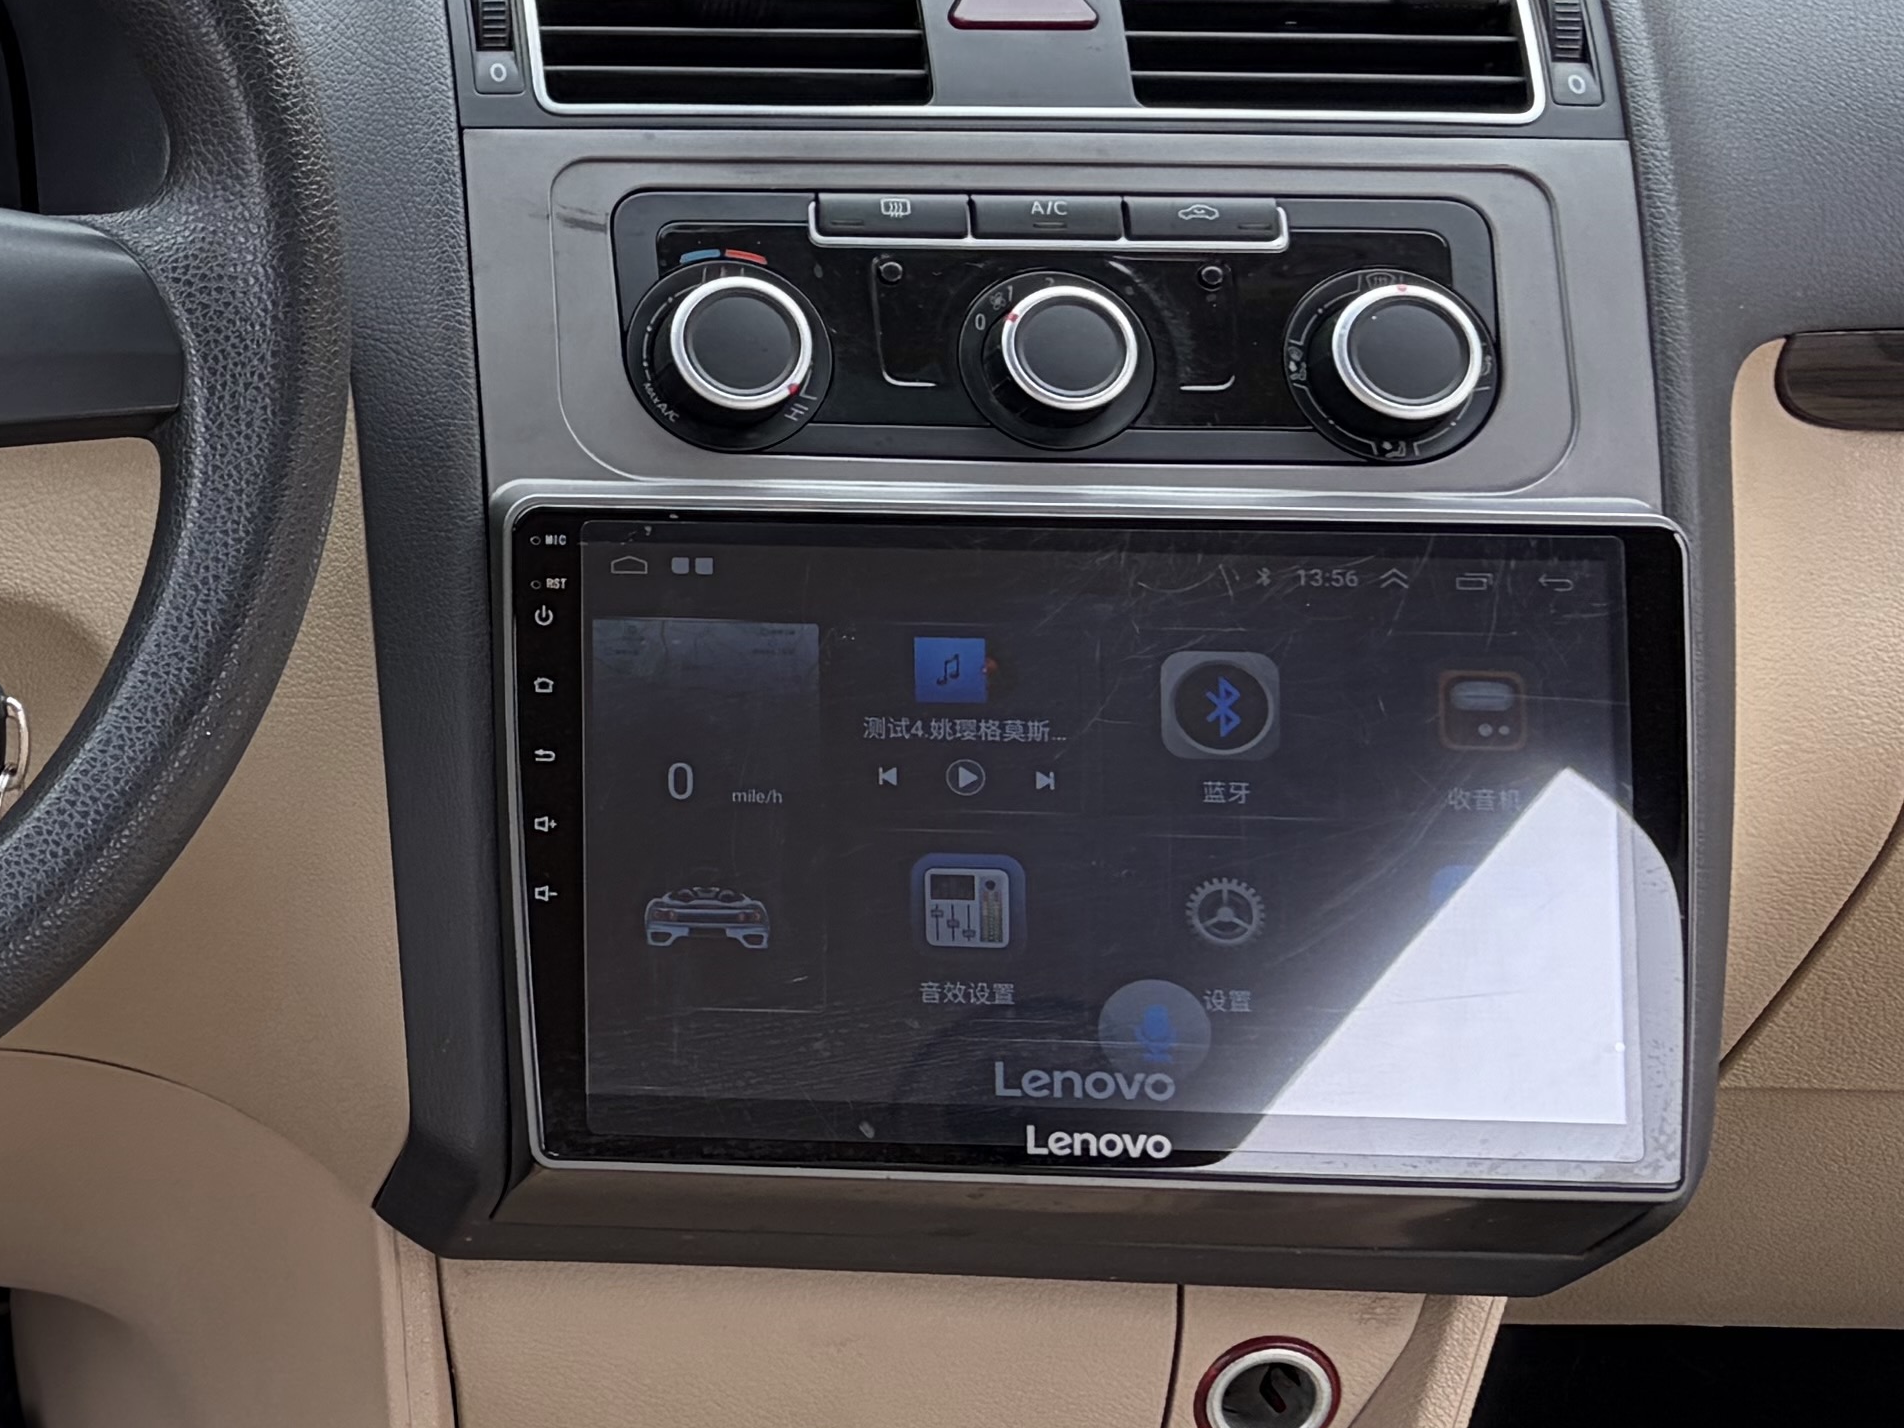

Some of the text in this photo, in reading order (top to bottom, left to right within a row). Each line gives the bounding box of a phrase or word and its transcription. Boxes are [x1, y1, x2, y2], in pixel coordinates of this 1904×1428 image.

[1030, 200, 1068, 216] A/C
[545, 534, 567, 546] MIC
[545, 577, 567, 590] RST
[1296, 569, 1359, 588] 13:56
[667, 762, 783, 804] 0 mile/h
[1202, 782, 1251, 805] 蓝牙
[919, 981, 1016, 1006] 音效设置
[1203, 989, 1253, 1013] 设置
[994, 1060, 1176, 1102] Lenovo
[1026, 1124, 1173, 1160] Lenovo
